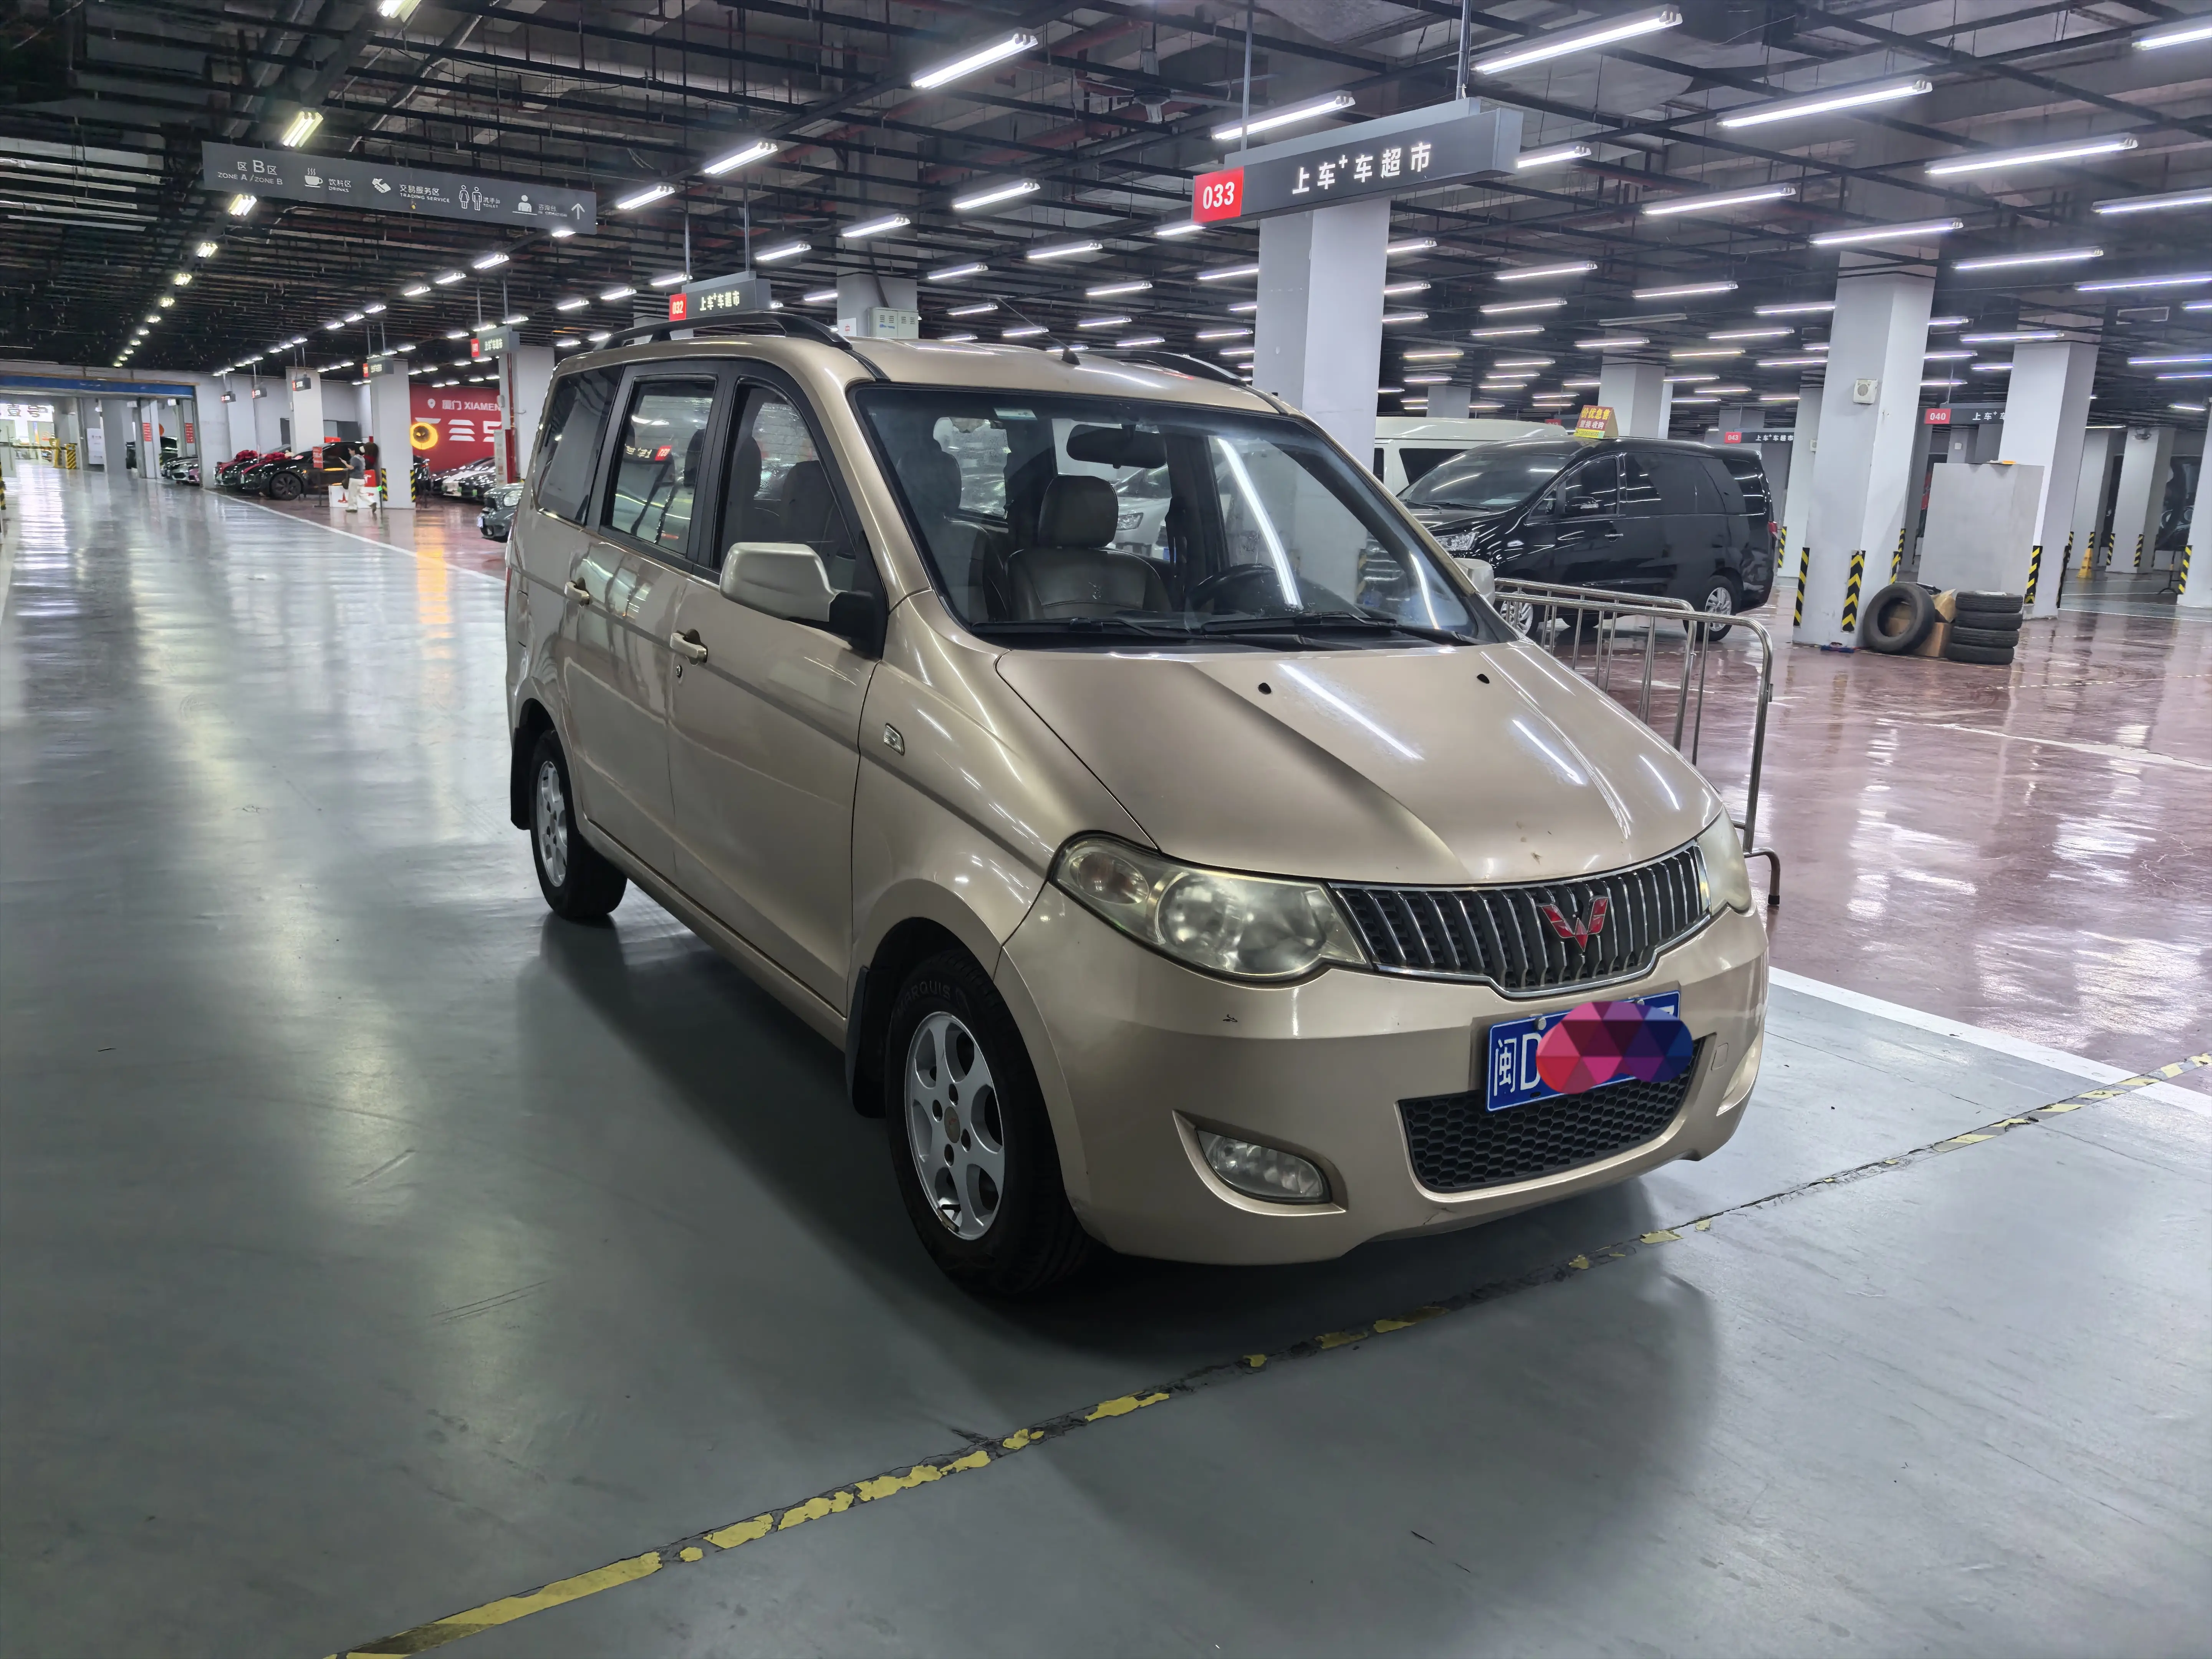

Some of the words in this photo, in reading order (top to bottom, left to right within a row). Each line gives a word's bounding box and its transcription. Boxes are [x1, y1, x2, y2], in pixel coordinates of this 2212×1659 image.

[1292, 142, 1431, 194] 上车+车超市
[218, 172, 238, 180] ZONE
[399, 184, 440, 196] 交易服务区
[1203, 182, 1235, 209] 033
[672, 300, 684, 315] 032
[464, 402, 501, 411] XIAMEN
